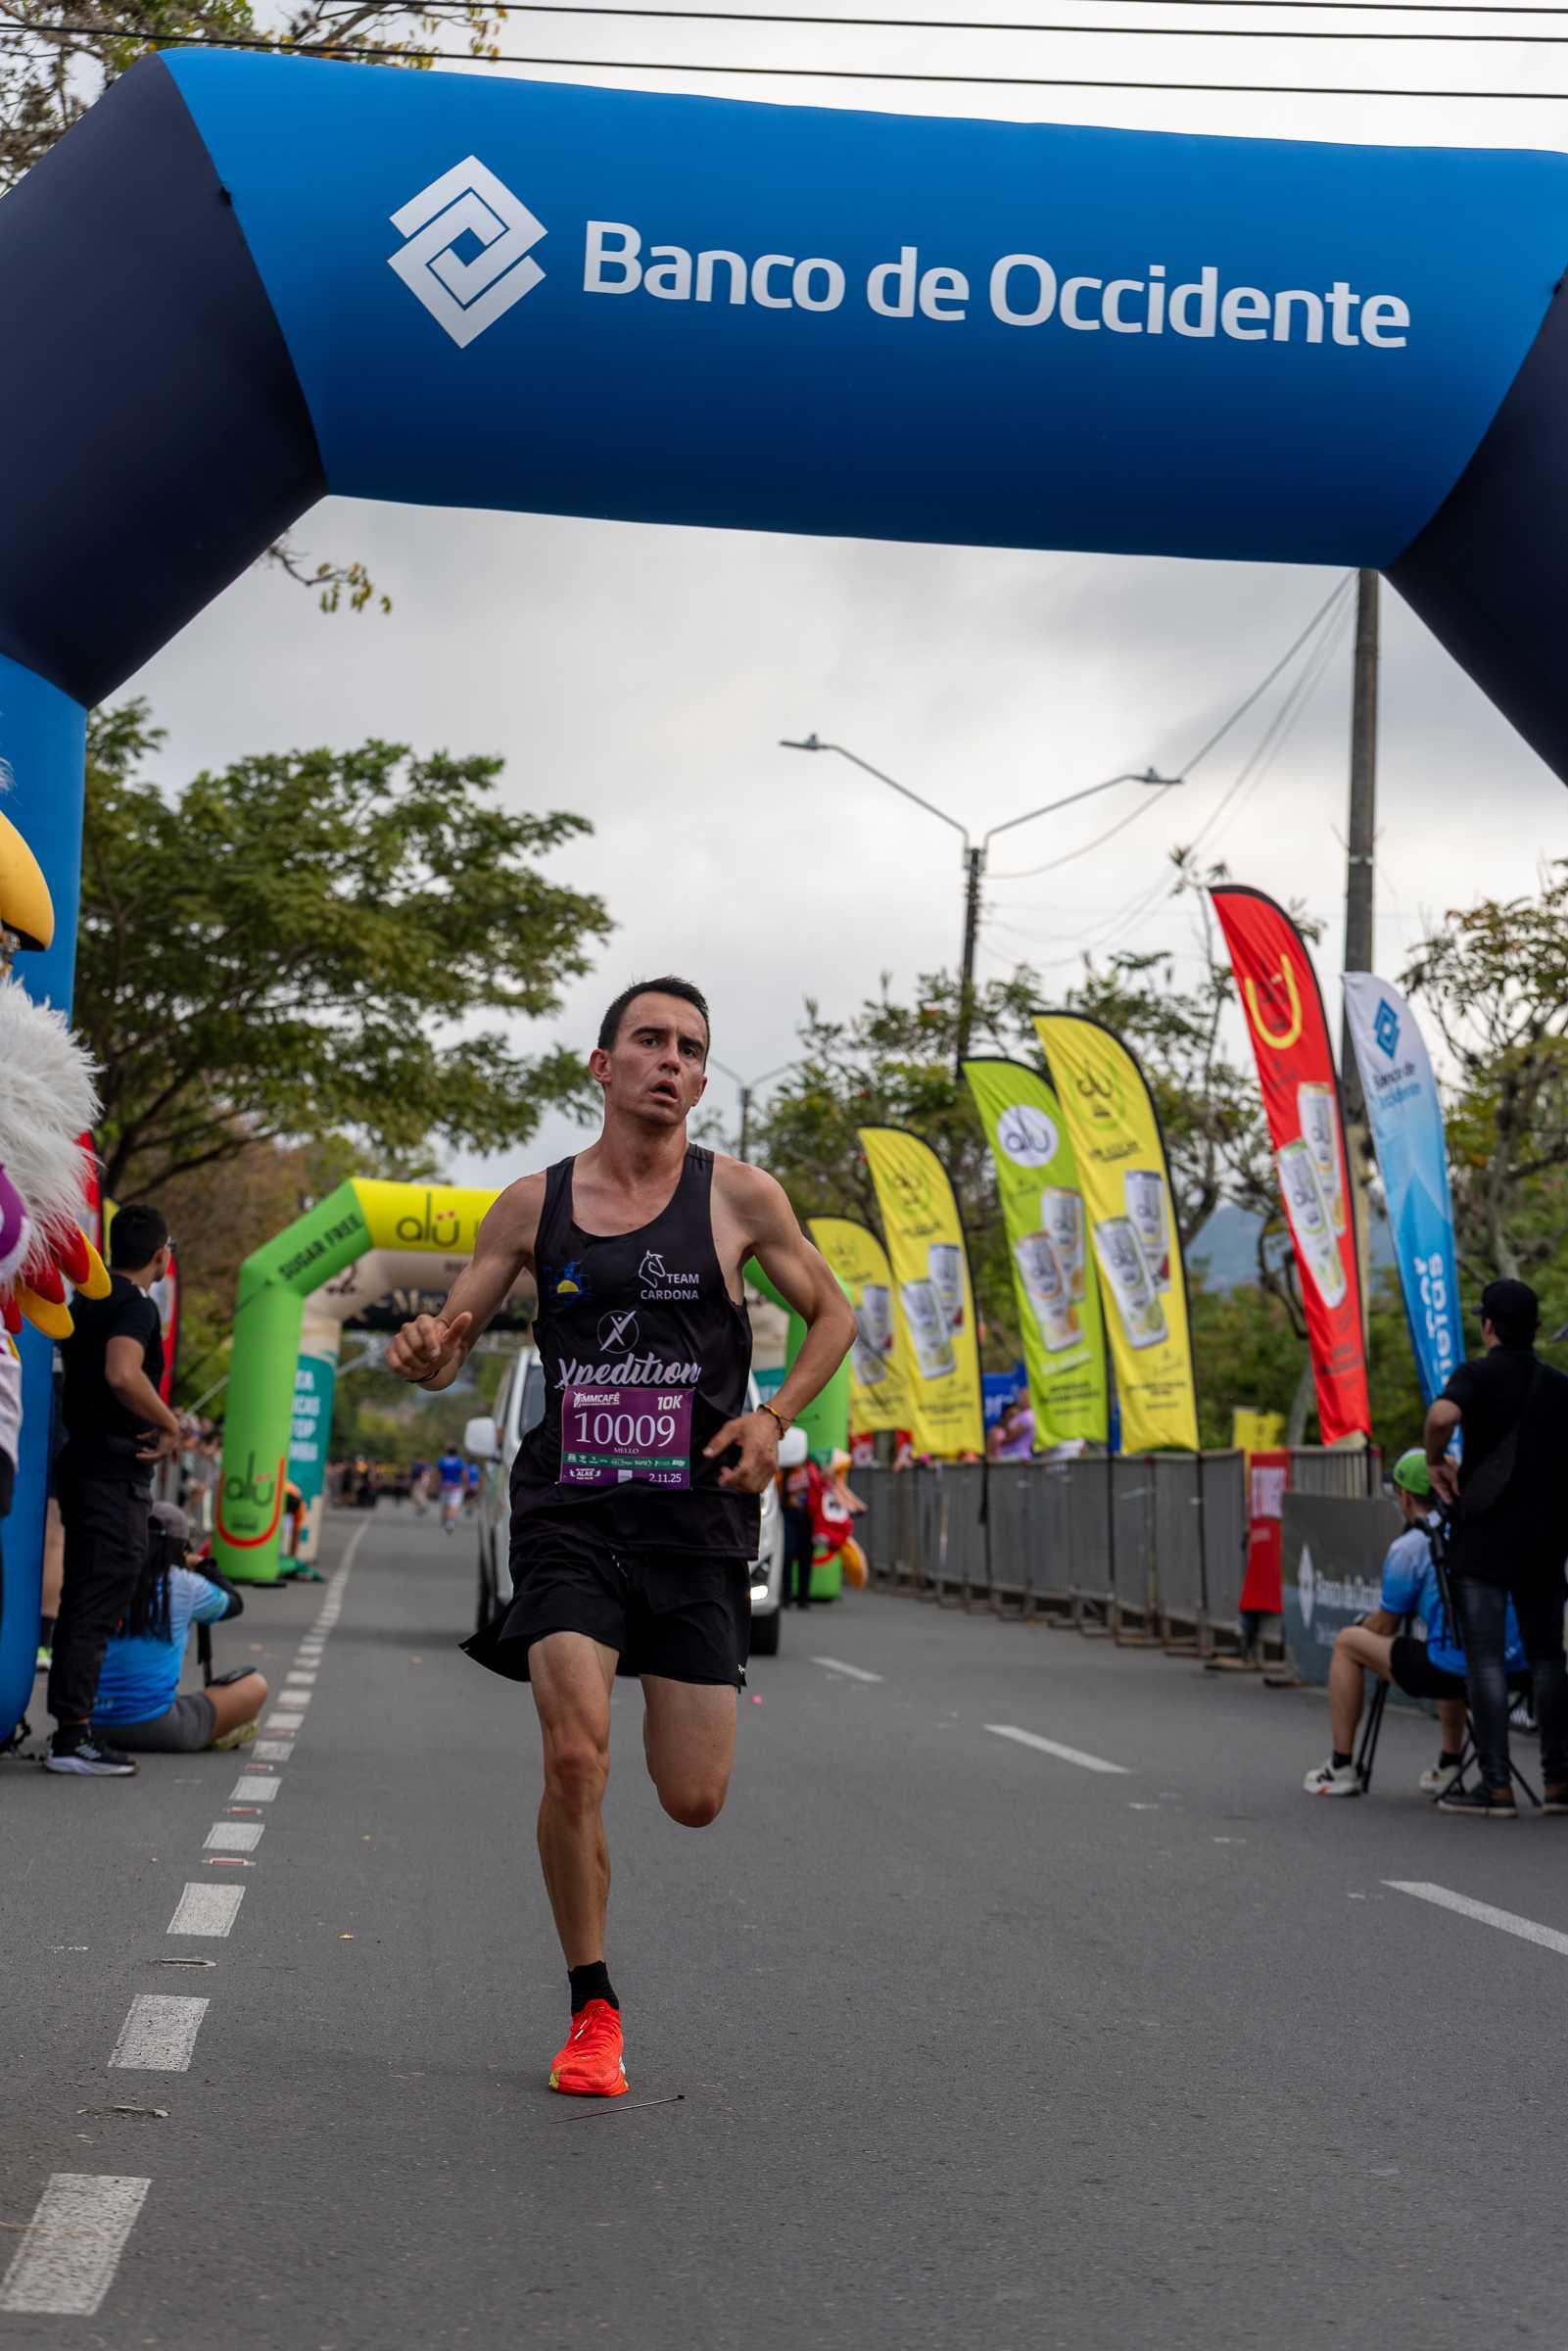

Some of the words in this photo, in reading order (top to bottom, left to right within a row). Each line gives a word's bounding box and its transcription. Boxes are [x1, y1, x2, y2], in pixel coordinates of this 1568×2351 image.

[583, 219, 845, 313] Banco
[866, 246, 970, 322] de
[989, 254, 1411, 348] Occidente
[278, 1237, 325, 1280] SUGAR
[323, 1212, 361, 1249] FREE
[666, 1272, 699, 1284] TEAM
[641, 1289, 699, 1300] CARDONA
[657, 1395, 683, 1411] 10K
[574, 1412, 675, 1447] 10009
[648, 1472, 682, 1483] 2.11.25
